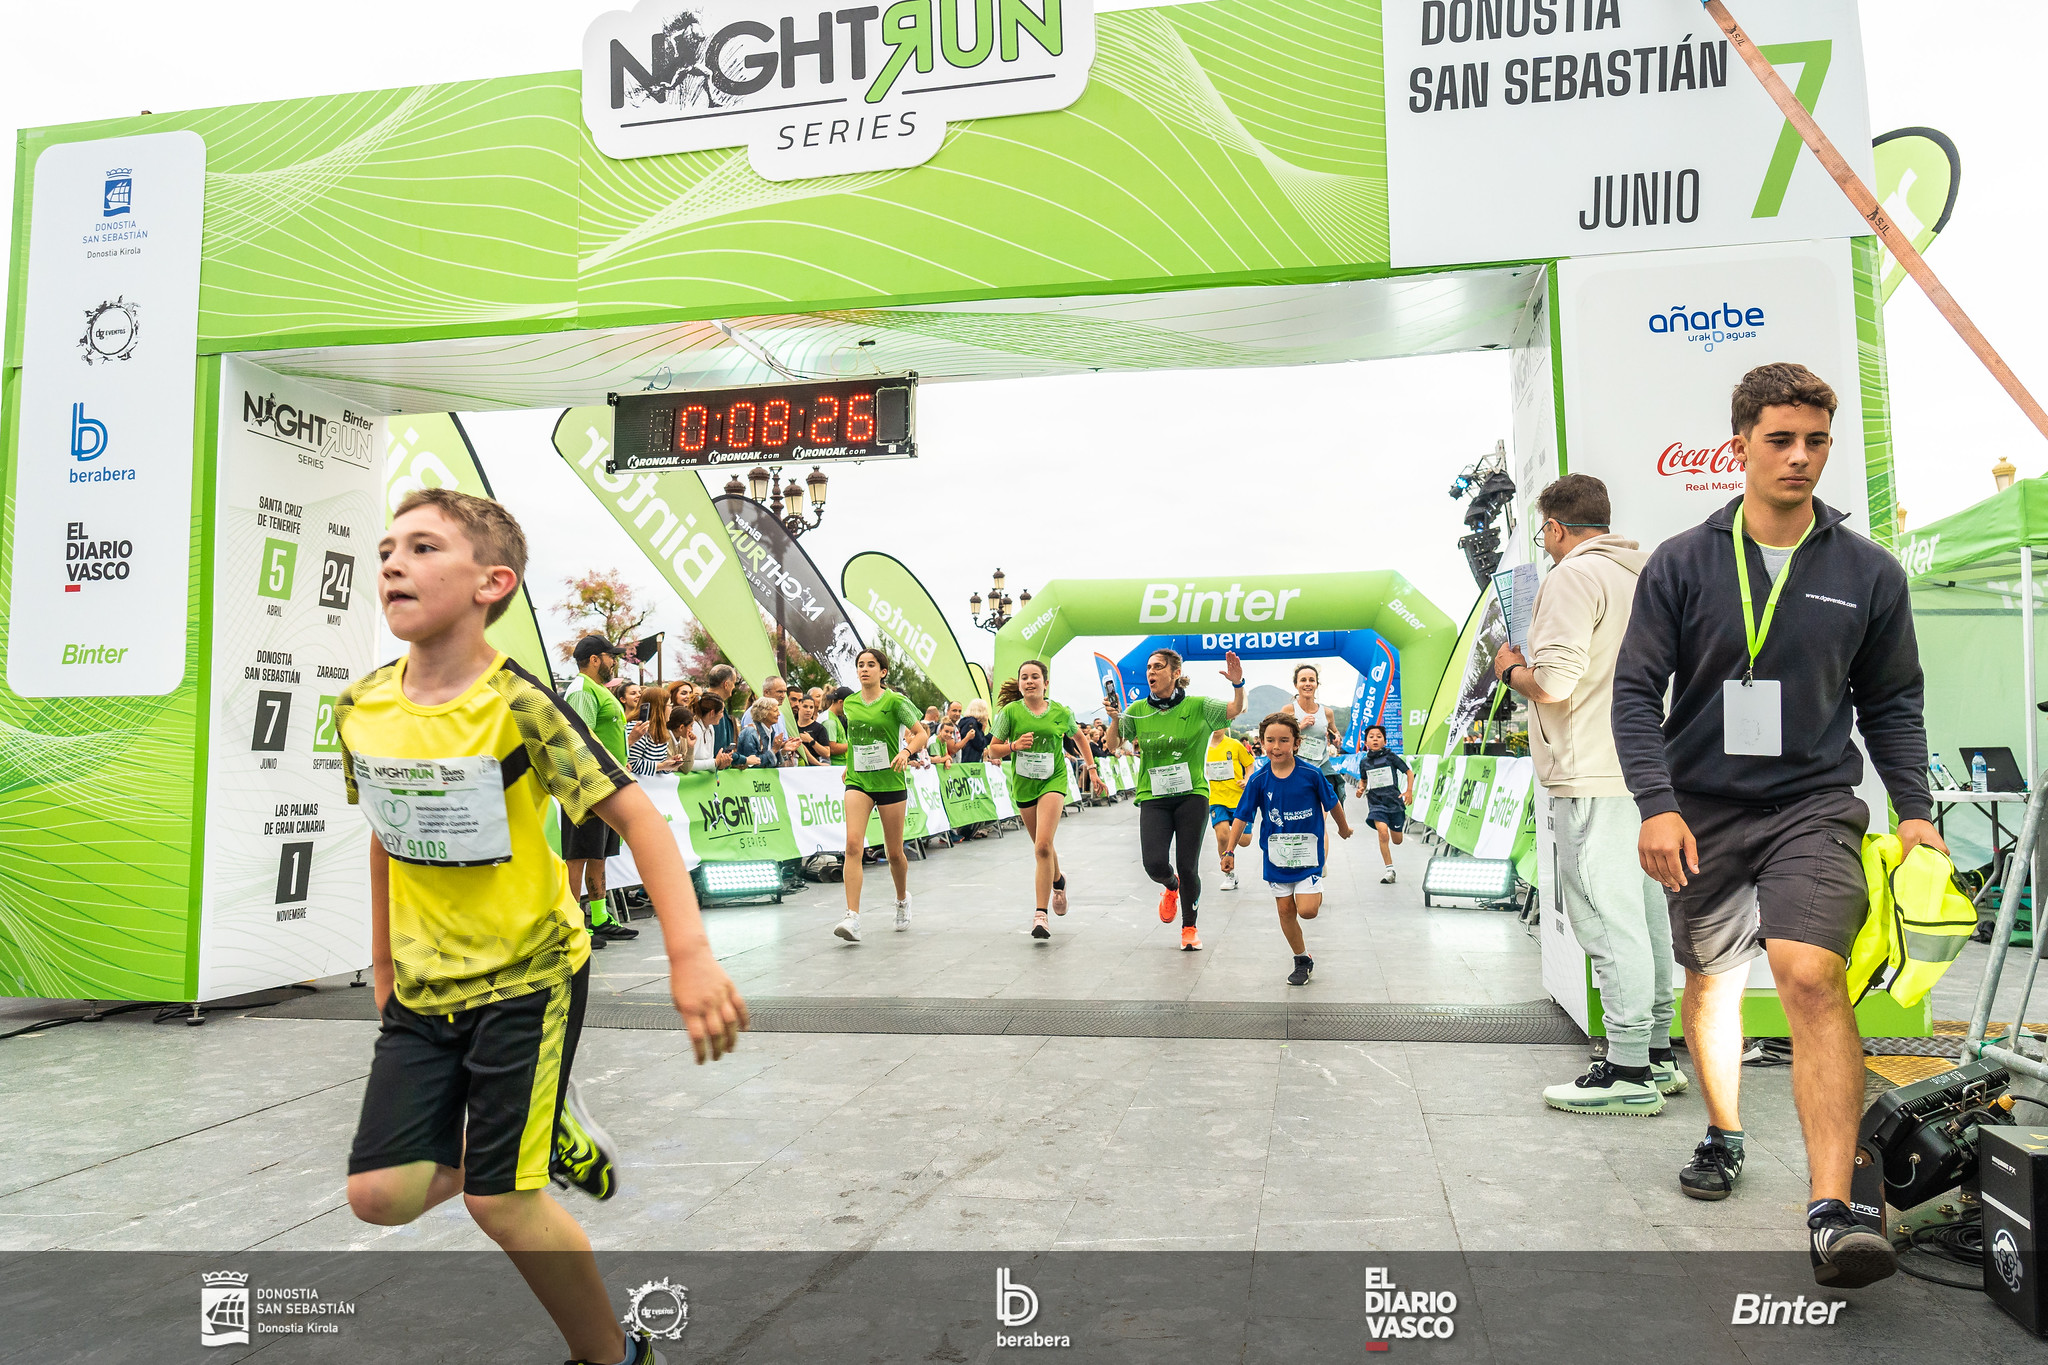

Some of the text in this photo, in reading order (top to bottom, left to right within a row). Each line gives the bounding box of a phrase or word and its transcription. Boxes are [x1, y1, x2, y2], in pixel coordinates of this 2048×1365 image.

[1409, 34, 1728, 113] SAN SEBASTIÁN
[776, 111, 918, 151] SERIES
[1751, 39, 1833, 219] 7
[1579, 169, 1700, 230] JUNIO
[95, 220, 137, 232] DONOSTIA
[1875, 217, 1890, 237] SJL
[82, 229, 149, 244] SAN SEBASTIÁN
[87, 246, 141, 259] Donostia Kirola
[1649, 302, 1765, 333] añarbe
[1688, 330, 1757, 342] urak aguas
[342, 409, 374, 431] Binter
[680, 394, 876, 451] 0:08:26
[298, 453, 324, 470] SERIES
[69, 467, 136, 484] berabera
[1685, 480, 1744, 492] Real Magic
[259, 496, 303, 518] SANTA CRUZ
[67, 522, 89, 541] EL
[257, 513, 301, 535] DE TENERIFE
[328, 522, 351, 539] PALMA
[66, 539, 133, 561] DIARIO
[66, 561, 130, 582] VASCO
[269, 548, 287, 592] 5
[321, 560, 350, 604] 24
[266, 604, 282, 617] ABRIL
[1138, 582, 1301, 624] Binter
[327, 614, 341, 626] MAYO
[1021, 607, 1055, 641] Binter
[1387, 598, 1426, 632] Binter
[61, 644, 128, 665] Binter
[257, 650, 292, 666] DONOSTIA
[244, 666, 301, 684] SAN SEBASTIÁN
[317, 666, 349, 680] ZARAGOZA
[263, 700, 281, 744] 7
[260, 758, 277, 770] JUNIO
[753, 780, 771, 793] Binter
[275, 803, 319, 817] LAS PALMAS
[264, 820, 326, 835] DE GRAN CANARIA
[407, 839, 447, 860] 9108
[740, 837, 767, 849] SERIES
[290, 851, 300, 895] 1
[276, 907, 307, 922] NOVIEMBRE
[1856, 1203, 1880, 1214] PRO
